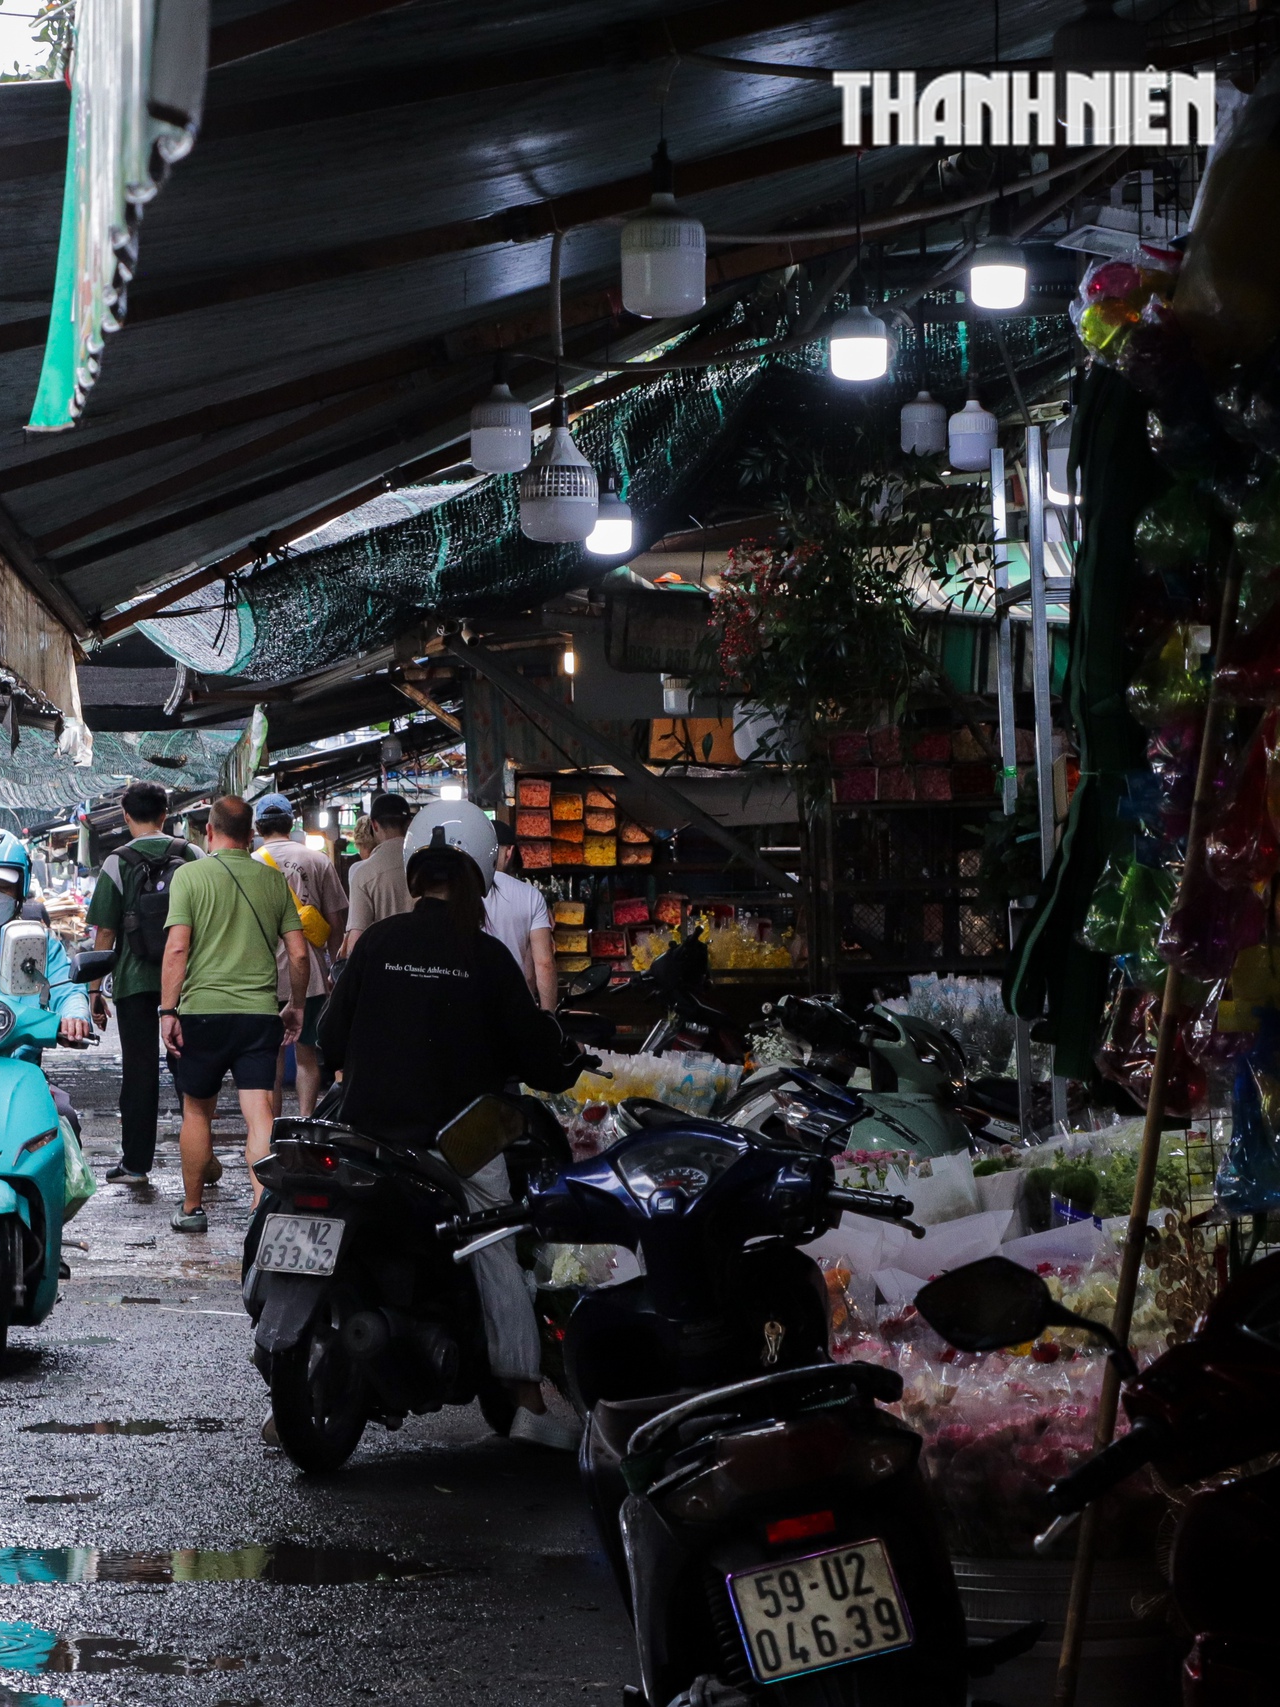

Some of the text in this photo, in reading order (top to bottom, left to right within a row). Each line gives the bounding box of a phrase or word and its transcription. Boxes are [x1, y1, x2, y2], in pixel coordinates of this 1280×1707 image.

[384, 962, 403, 971] Fredo
[403, 964, 426, 973] Classic
[426, 966, 451, 976] Athletic
[274, 1219, 332, 1246] 79-N2
[754, 1552, 875, 1619] 59-U2
[755, 1597, 902, 1672] 046.39
